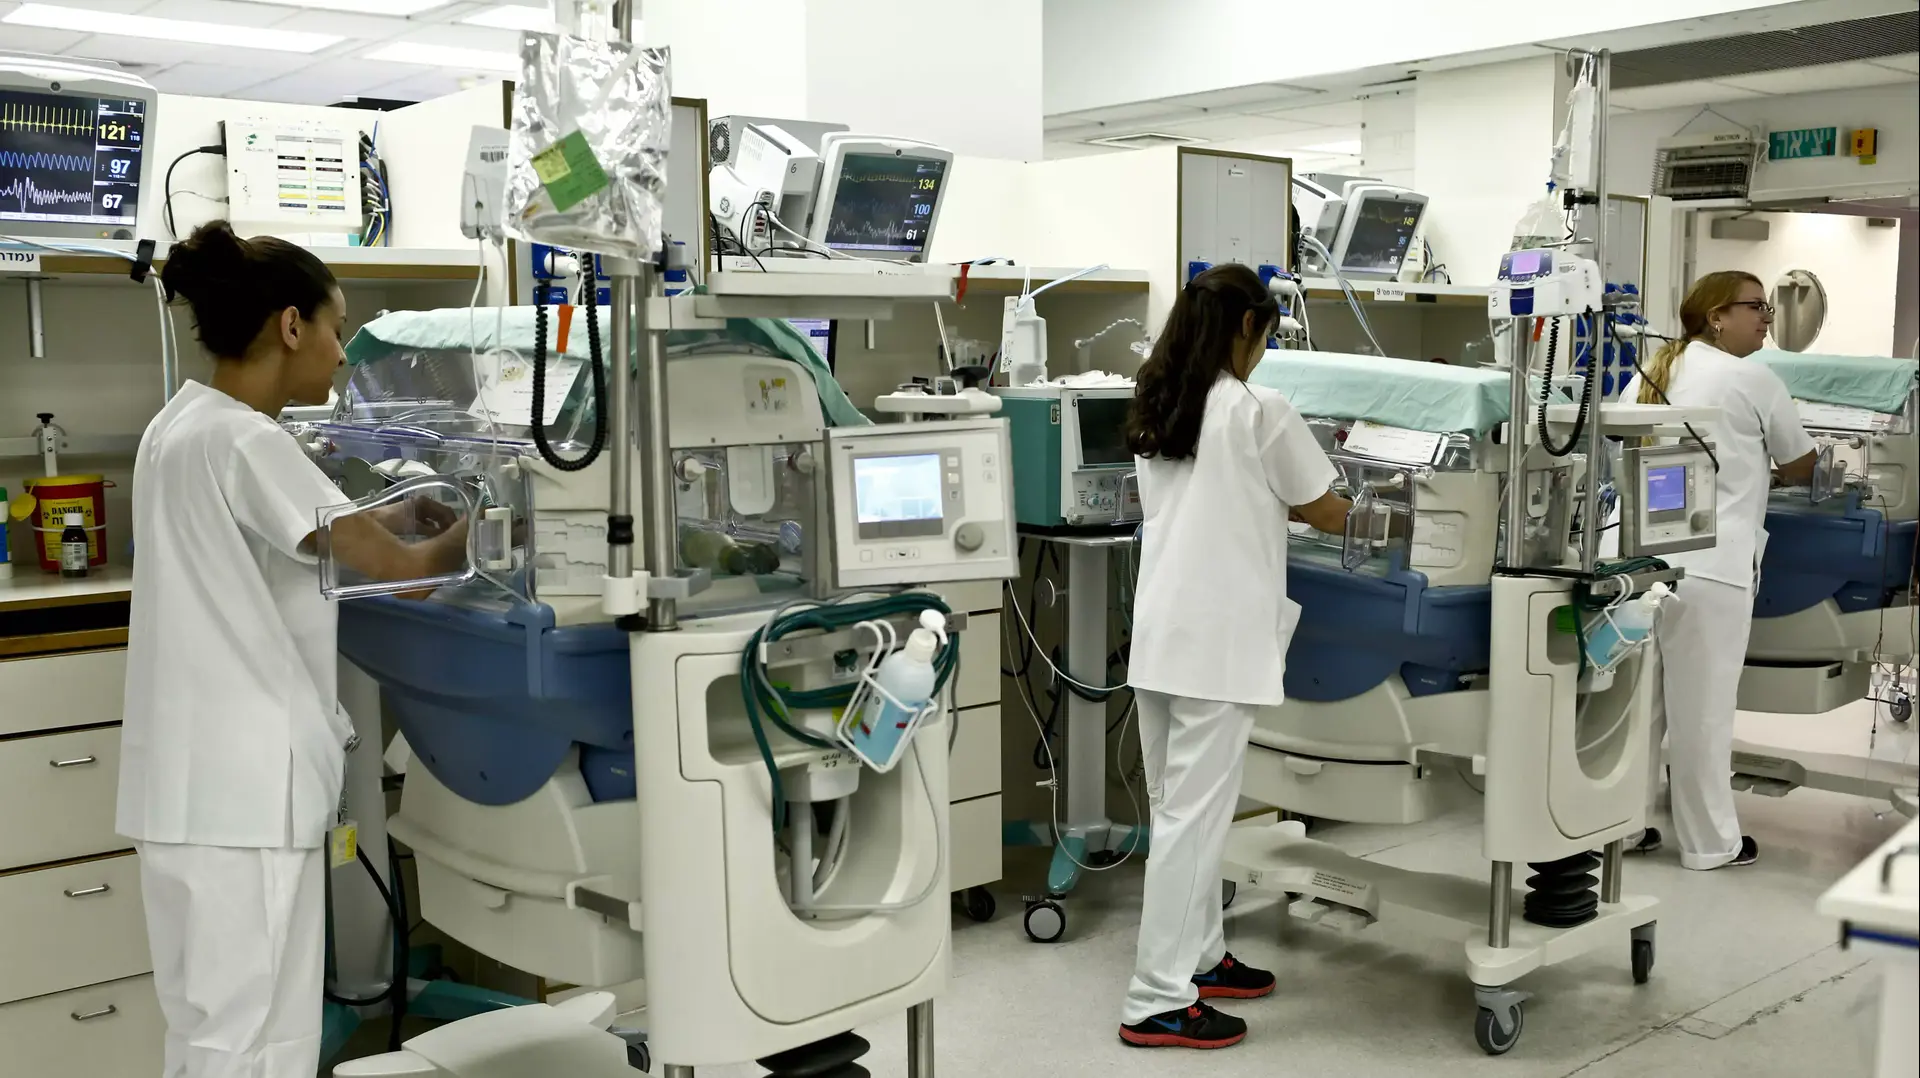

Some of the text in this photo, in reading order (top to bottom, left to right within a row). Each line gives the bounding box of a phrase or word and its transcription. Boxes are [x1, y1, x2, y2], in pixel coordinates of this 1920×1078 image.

[99, 124, 126, 140] 121
[110, 159, 131, 174] 97
[791, 163, 797, 173] 6
[918, 179, 935, 190] 134
[102, 194, 122, 209] 67
[914, 203, 931, 215] 100
[906, 229, 918, 240] 61
[1376, 287, 1381, 295] 9
[1492, 297, 1498, 307] 5
[1072, 399, 1077, 407] 6
[51, 506, 83, 514] DANGER
